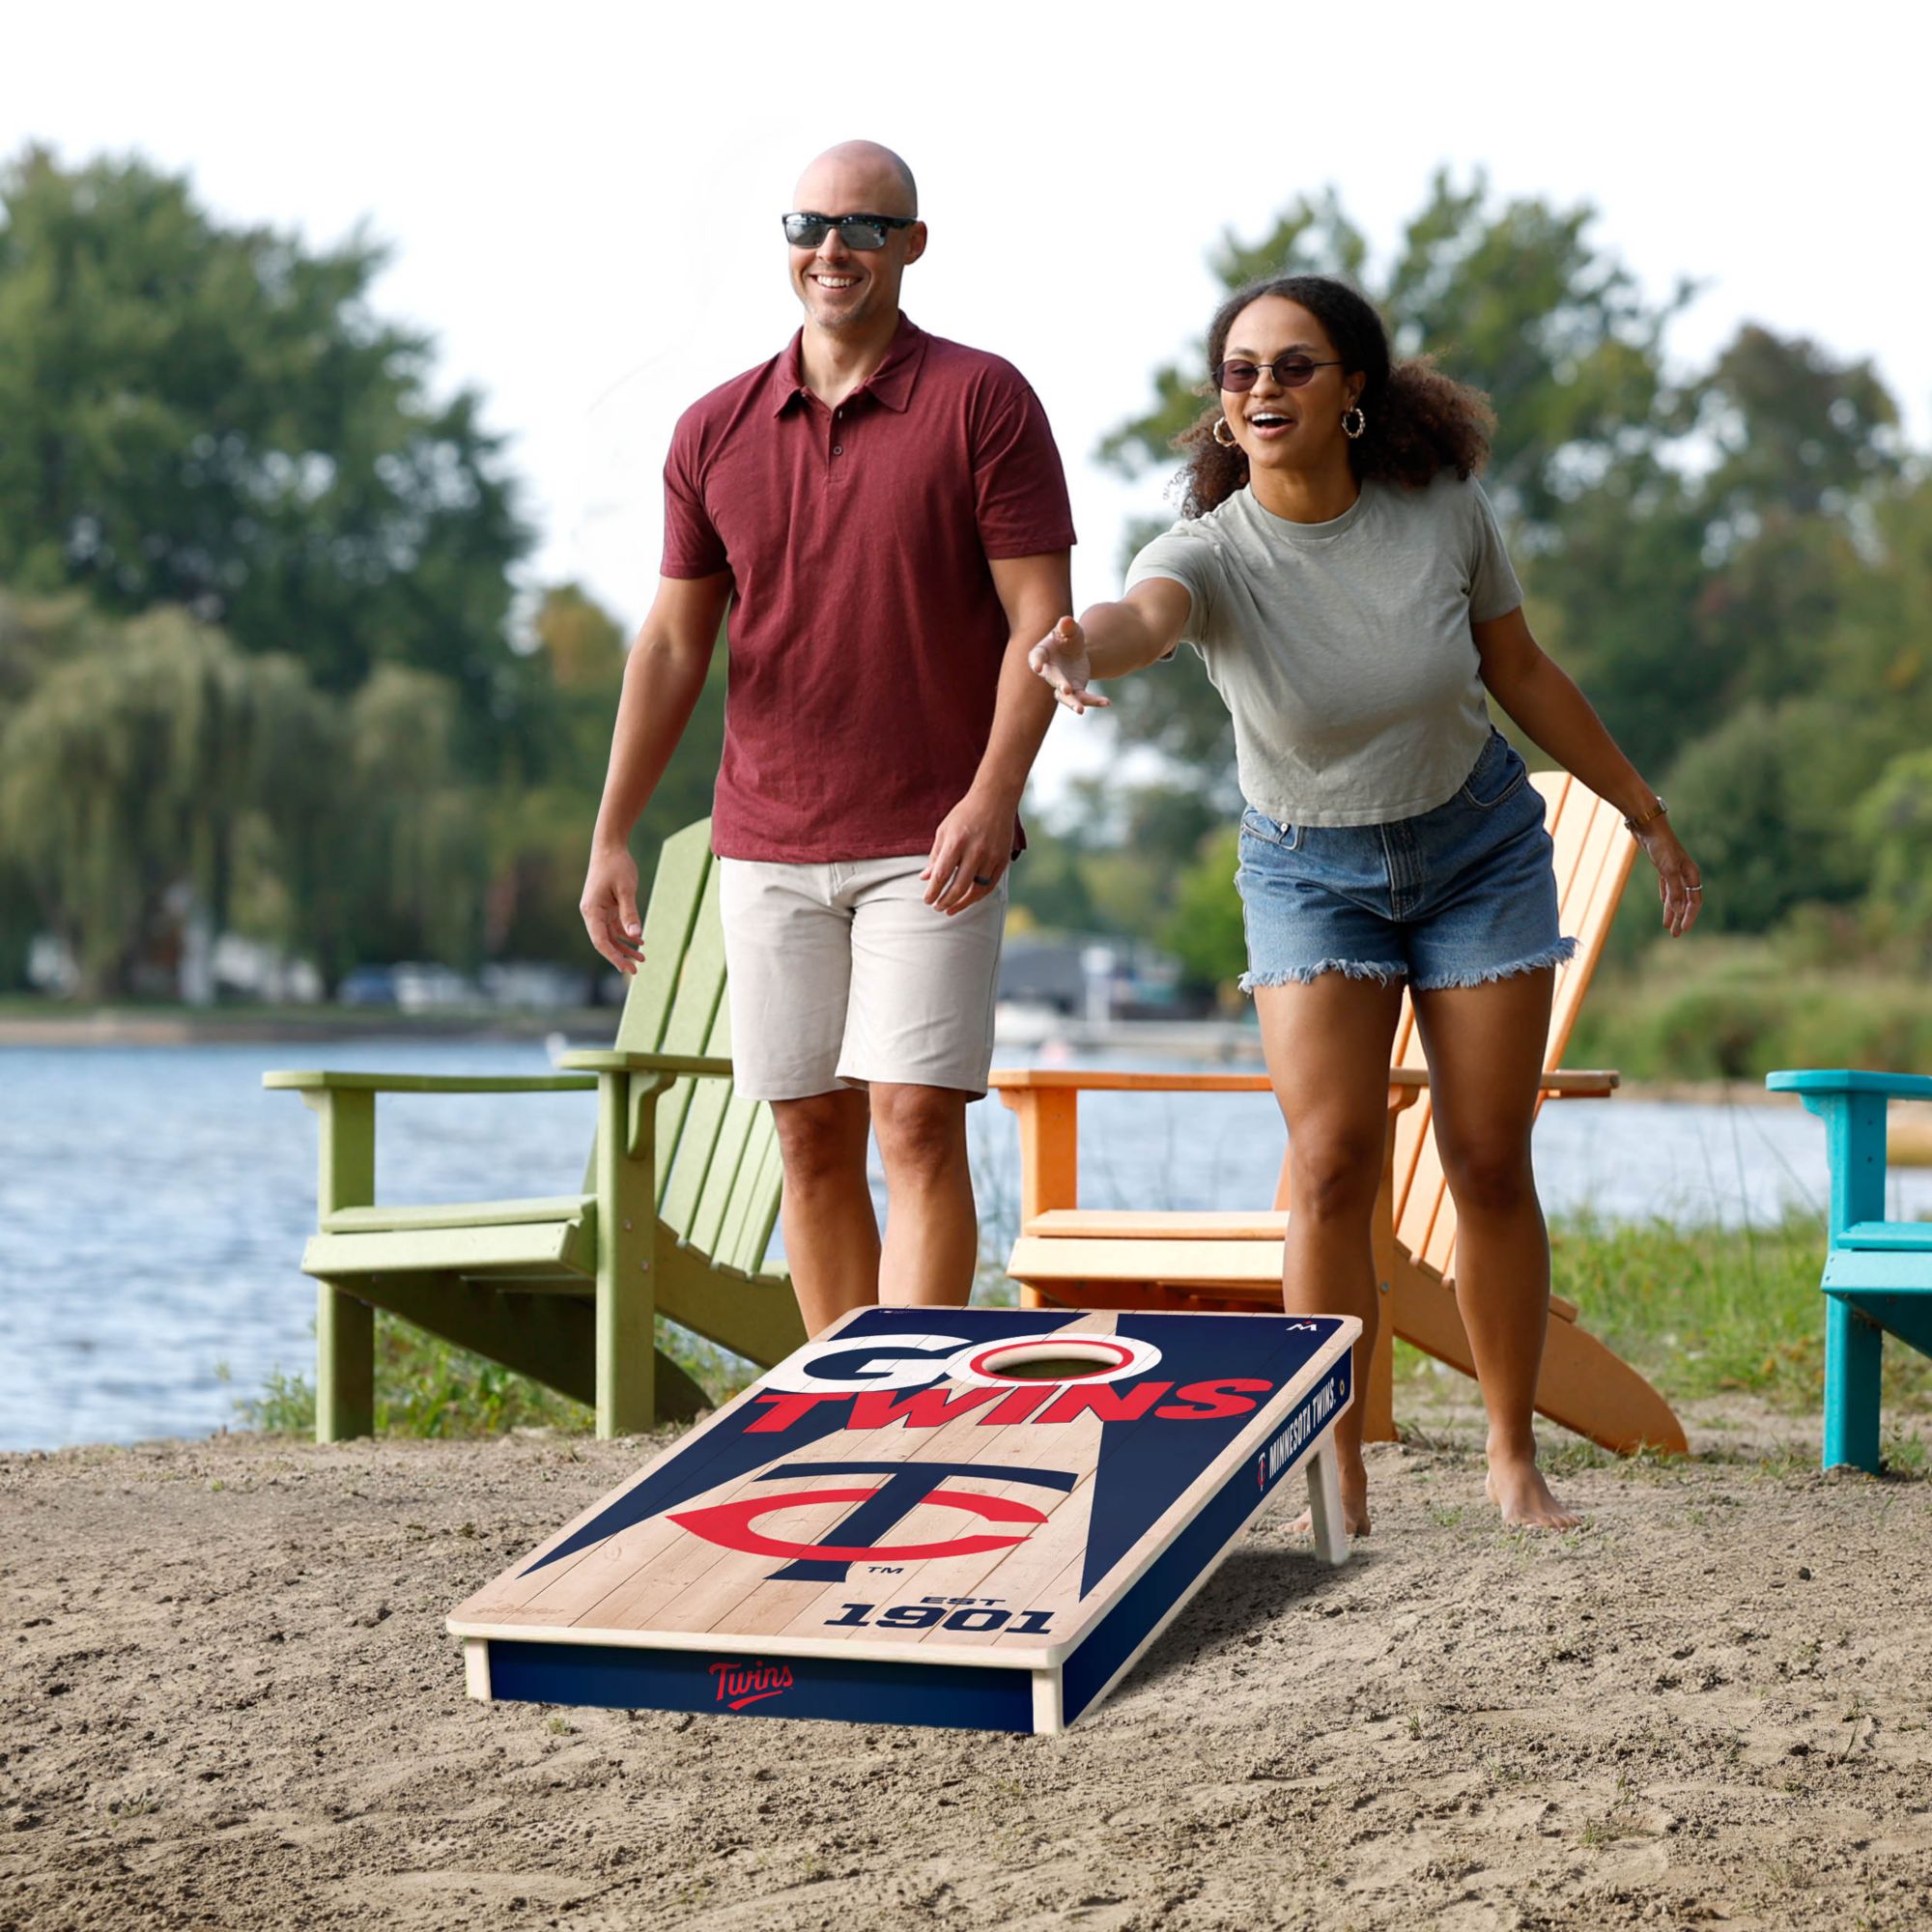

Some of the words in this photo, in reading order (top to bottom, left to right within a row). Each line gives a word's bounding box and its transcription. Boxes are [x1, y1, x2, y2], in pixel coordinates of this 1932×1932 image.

[755, 1334, 1163, 1394] GO
[742, 1378, 1273, 1434] TWINS
[1268, 1407, 1312, 1480] MINNESOTA
[867, 1566, 904, 1575] TM
[823, 1603, 1055, 1634] 1901
[919, 1596, 1007, 1606] EST
[708, 1660, 794, 1701] Twins
